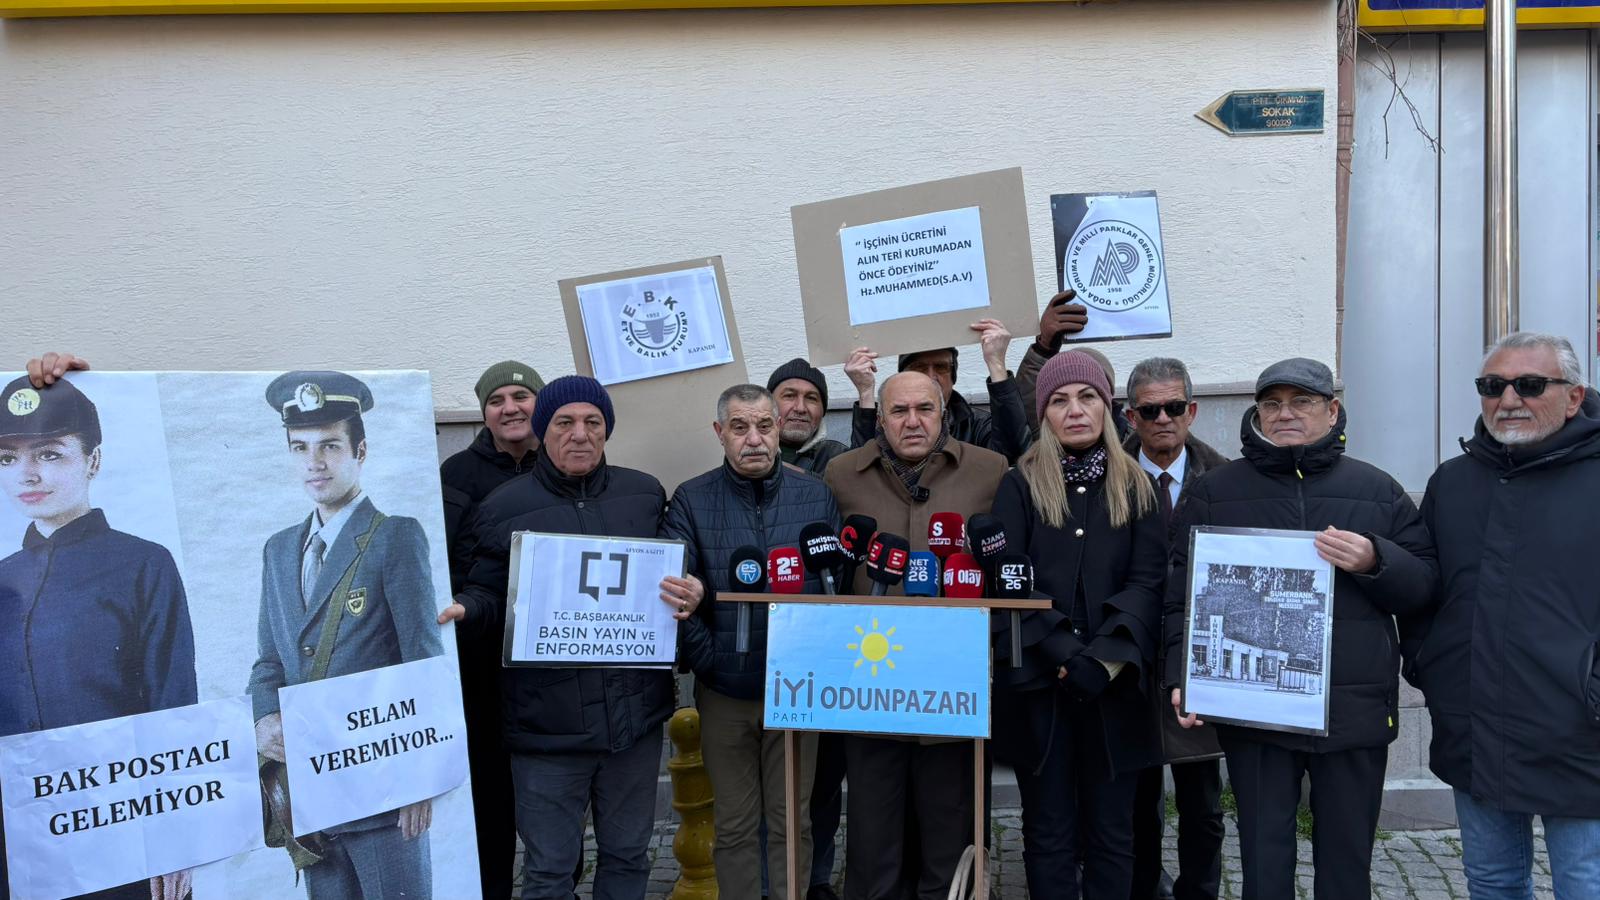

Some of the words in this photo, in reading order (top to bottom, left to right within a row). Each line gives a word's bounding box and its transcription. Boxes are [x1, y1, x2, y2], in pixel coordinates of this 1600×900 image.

[1262, 107, 1296, 117] SOKAK
[863, 234, 899, 251] İŞÇİNİN
[901, 225, 947, 243] ÜCRETİNİ
[1079, 229, 1099, 246] MİLLİ
[1099, 225, 1138, 240] PARKLAR
[857, 255, 880, 266] ALIN
[881, 249, 903, 262] TERİ
[904, 239, 972, 258] KURUMADAN
[1073, 245, 1082, 257] VE
[1138, 238, 1154, 263] GENEL
[858, 269, 886, 281] ÖNCE
[1071, 259, 1087, 293] KORUMA
[1087, 292, 1112, 306] DOĞA
[621, 320, 629, 333] ET
[625, 335, 634, 347] VE
[637, 347, 669, 358] BALIK
[671, 311, 689, 352] KURUMU
[932, 521, 943, 536] S
[981, 531, 1005, 546] AJANS
[742, 573, 755, 581] TV
[908, 571, 928, 581] 26
[1002, 564, 1024, 575] GZT
[777, 574, 800, 582] HABER
[958, 569, 981, 587] Olay
[1005, 579, 1021, 590] 26
[553, 612, 571, 621] T.C.
[574, 612, 645, 623] BAŞBAKANLIK
[539, 626, 587, 639] BASIN
[593, 627, 637, 640] YAYIN
[641, 631, 655, 641] VE
[536, 643, 656, 656] ENFORMASYON
[820, 686, 977, 715] ODUNPAZARI
[347, 698, 417, 731] SELAM
[773, 712, 813, 723] PARTİ
[309, 730, 454, 775] VEREMİYOR...
[32, 764, 101, 799] BAK
[108, 739, 231, 783] POSTACI
[49, 780, 225, 837] GELEMİYOR
